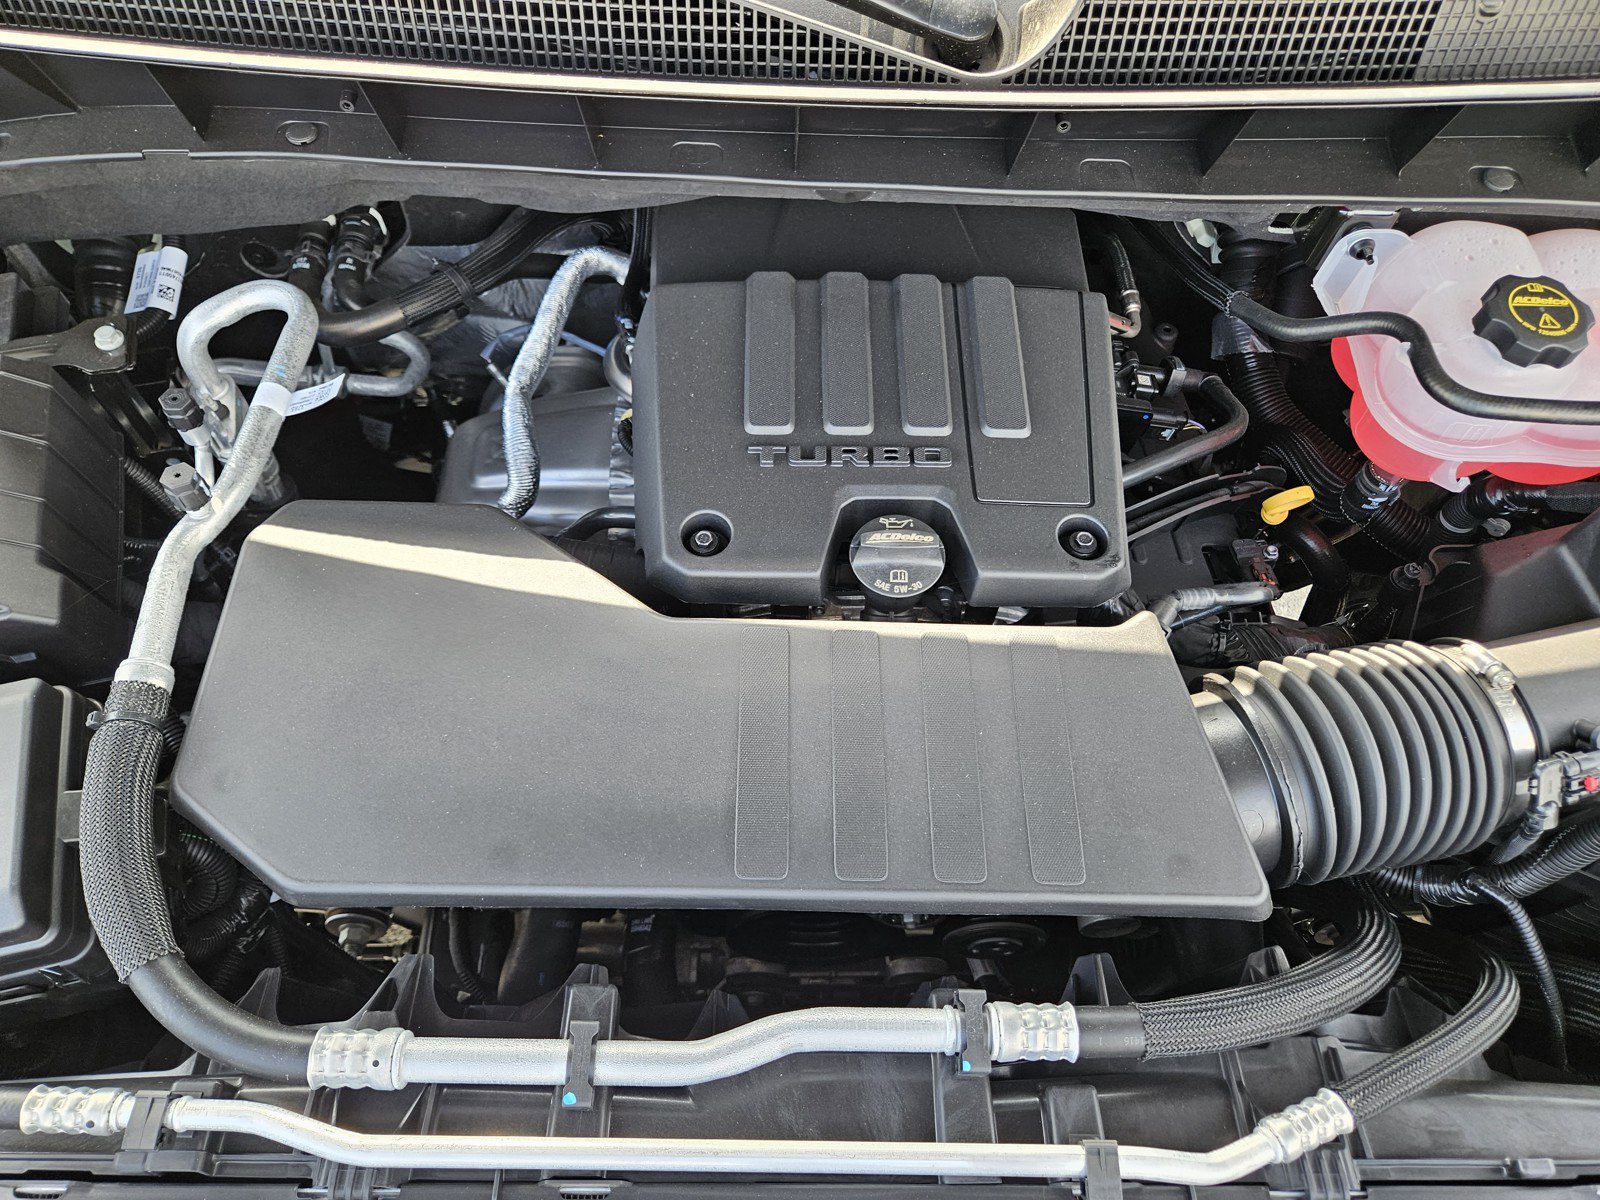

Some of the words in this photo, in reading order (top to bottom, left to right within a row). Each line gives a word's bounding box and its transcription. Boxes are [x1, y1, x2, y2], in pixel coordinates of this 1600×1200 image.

[1513, 296, 1569, 306] ACDelco
[747, 446, 953, 468] TURBO
[867, 532, 934, 543] ACDelco
[874, 579, 891, 592] SAE
[893, 580, 923, 594] 5W-30
